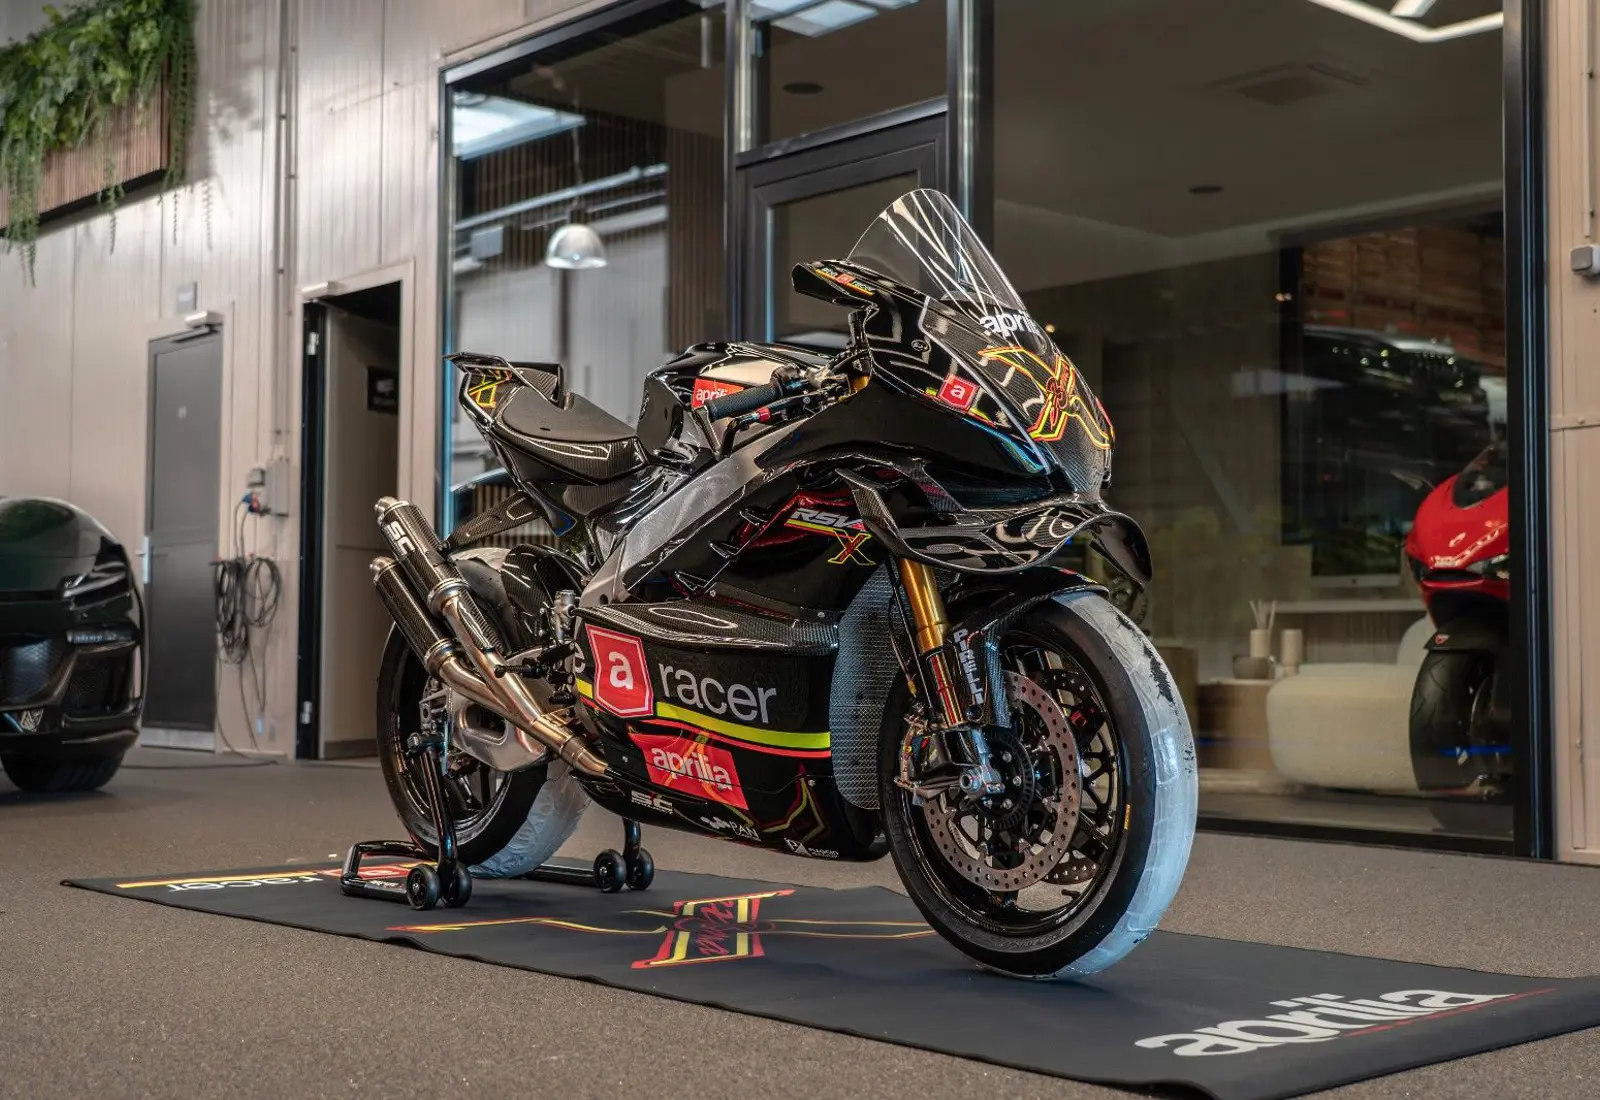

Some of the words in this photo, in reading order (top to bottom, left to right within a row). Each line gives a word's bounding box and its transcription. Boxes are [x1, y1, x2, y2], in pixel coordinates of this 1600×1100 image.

[950, 385, 966, 401] a
[384, 520, 416, 556] SC
[608, 651, 633, 690] a
[658, 662, 777, 724] racer
[954, 628, 984, 706] PIRELLI
[651, 747, 733, 791] aprilia
[1134, 989, 1517, 1057] aprilia
